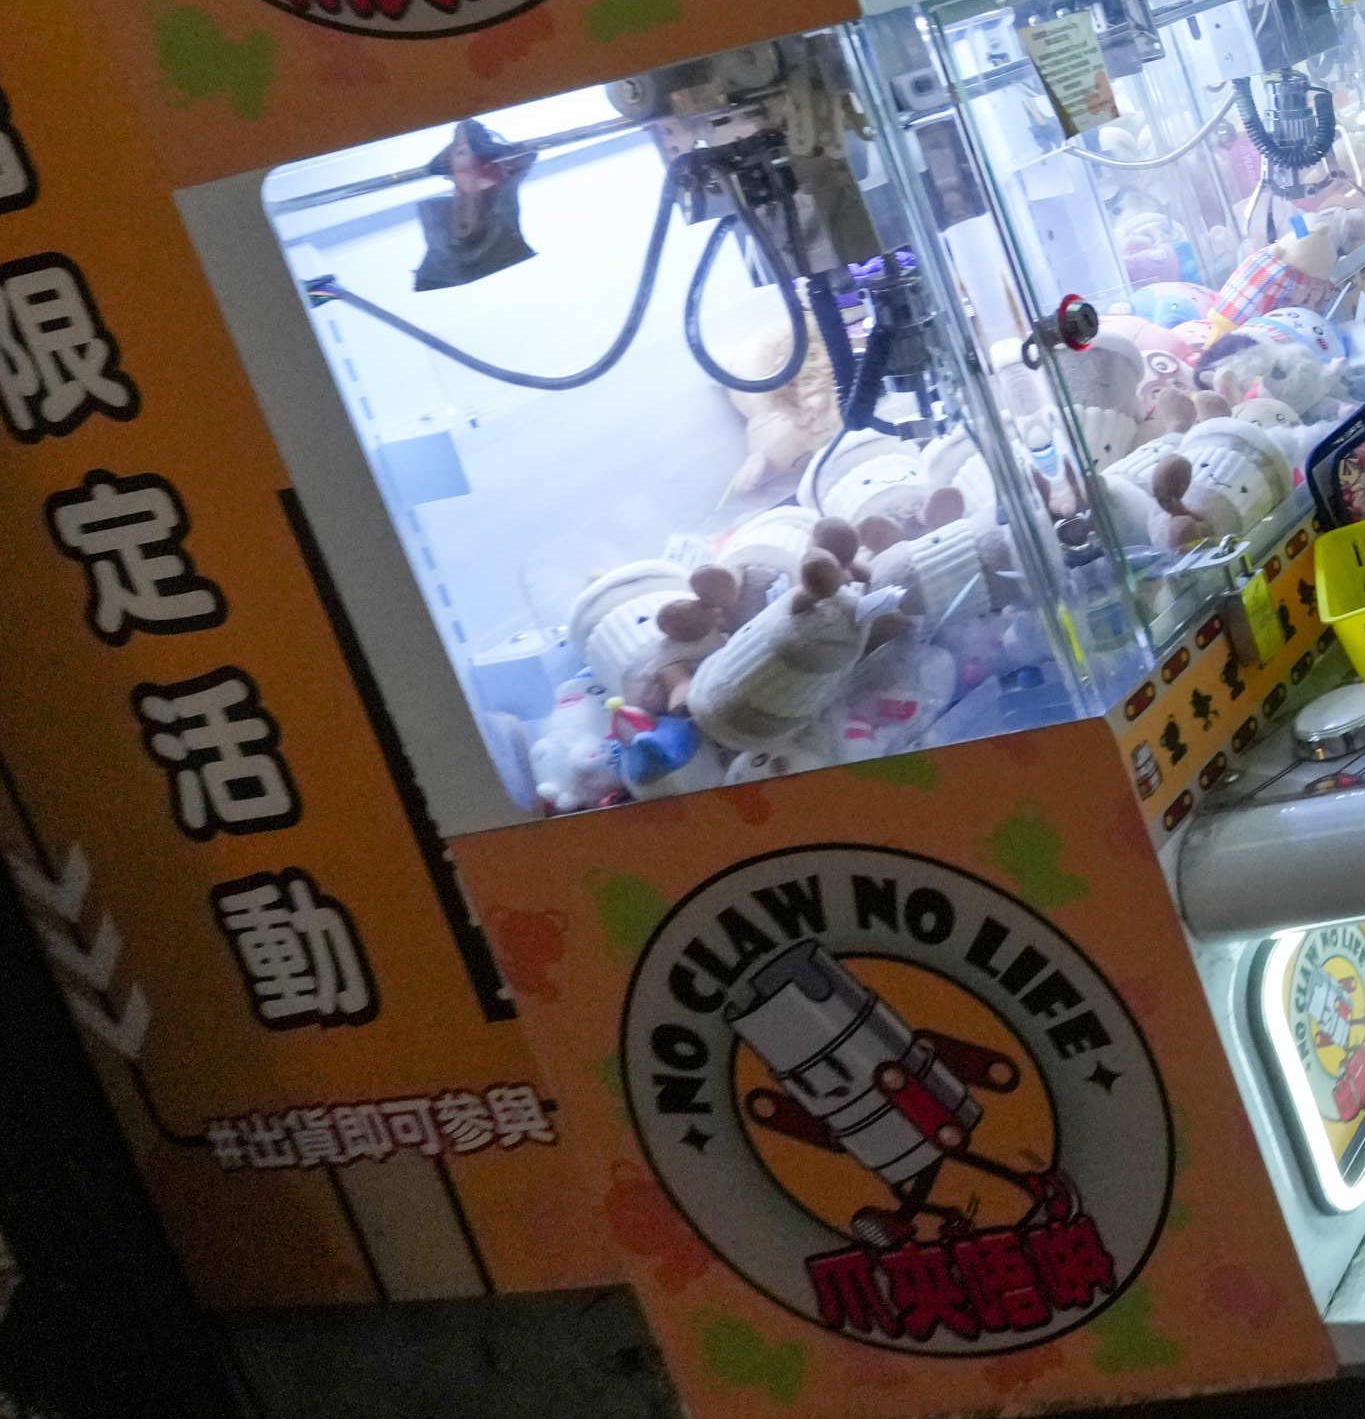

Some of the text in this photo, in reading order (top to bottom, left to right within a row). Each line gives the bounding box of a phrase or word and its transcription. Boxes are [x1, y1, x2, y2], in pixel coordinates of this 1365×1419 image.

[650, 873, 1114, 1116] NO CLAW NO LIFE
